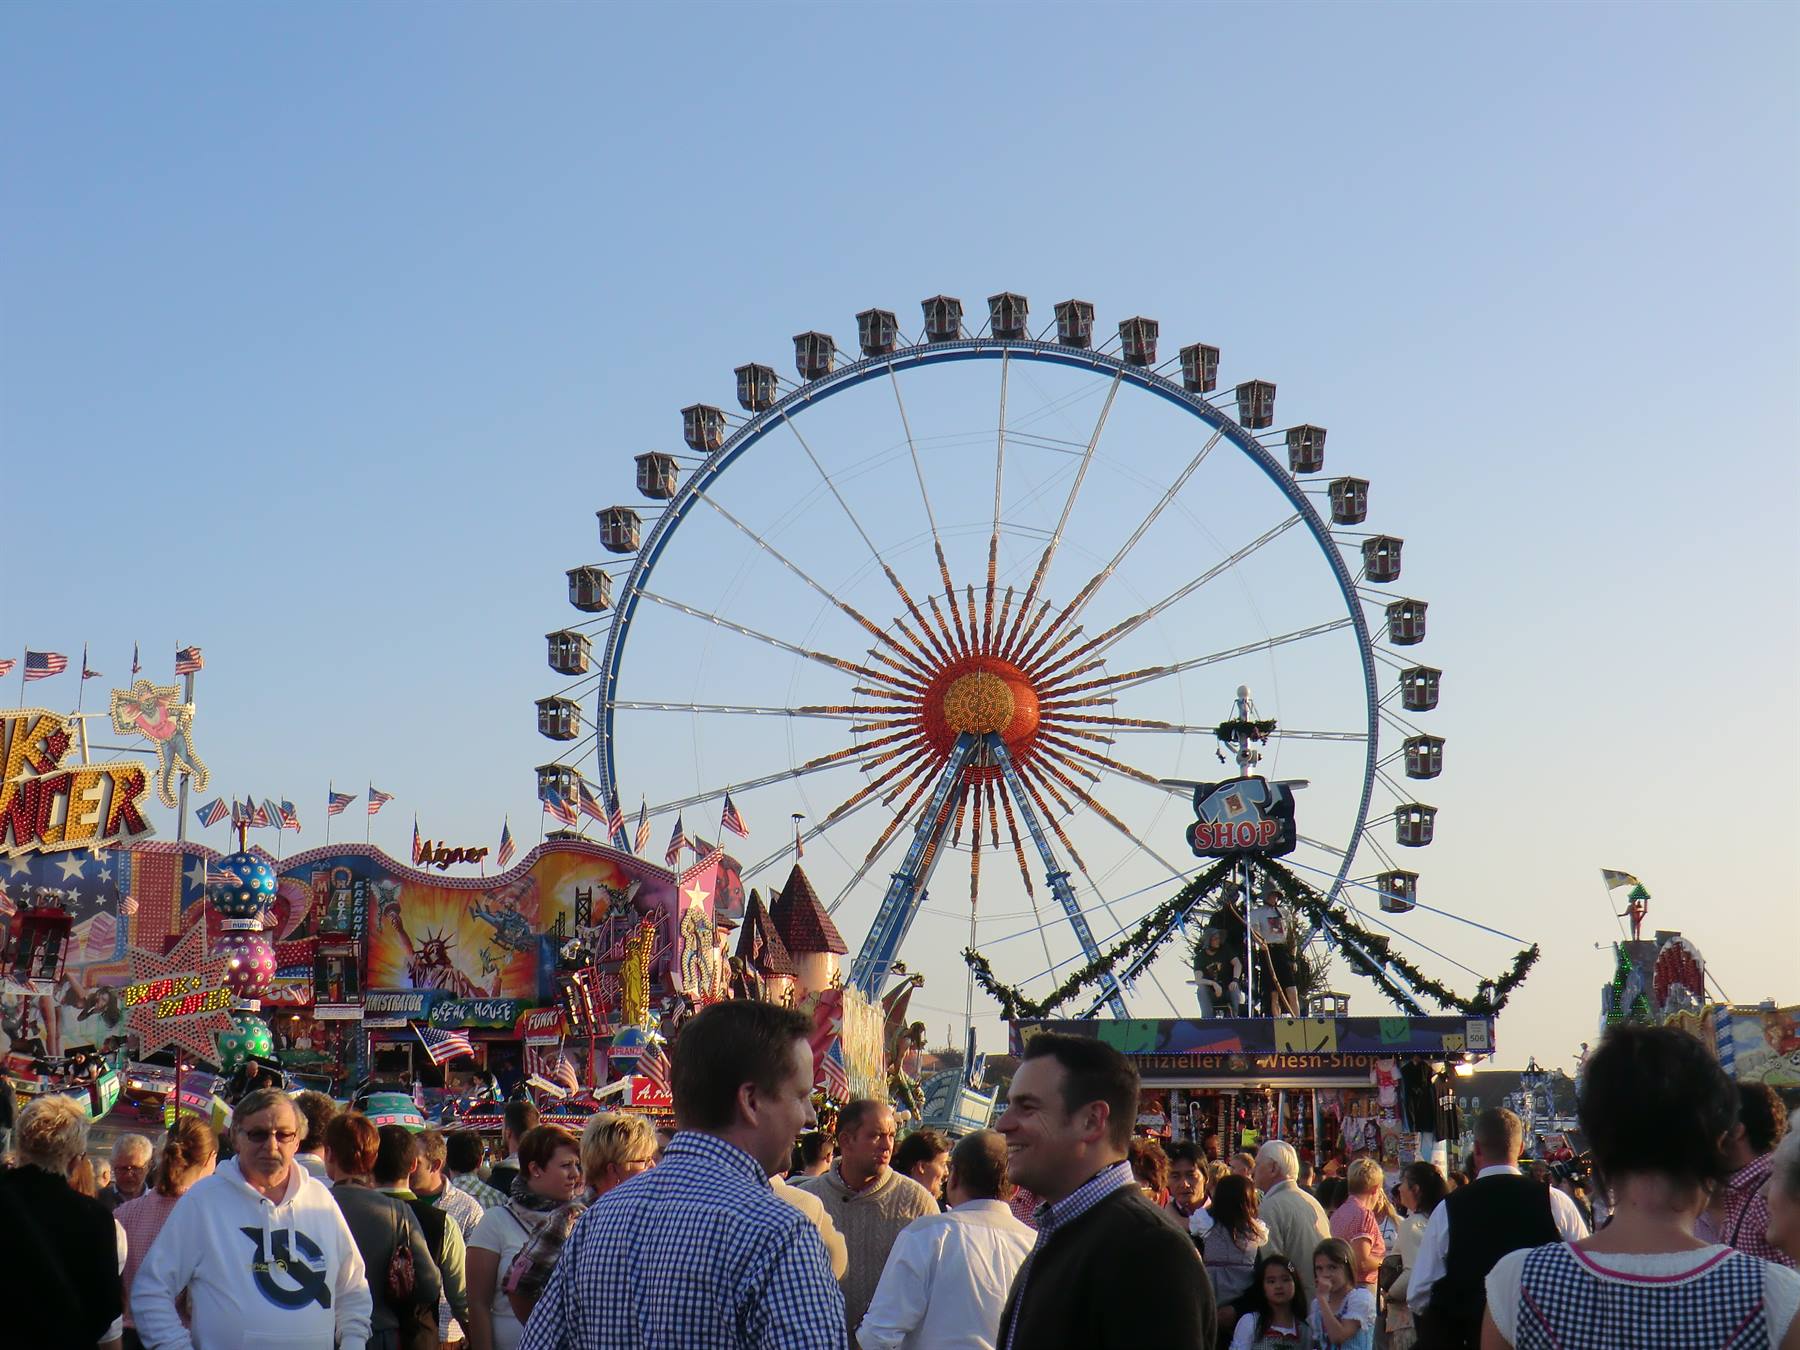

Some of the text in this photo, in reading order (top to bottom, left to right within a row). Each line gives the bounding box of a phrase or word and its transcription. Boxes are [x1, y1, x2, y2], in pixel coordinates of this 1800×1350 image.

[1194, 820, 1277, 849] SHOP
[416, 839, 488, 871] Aigner
[125, 976, 189, 1006] BREAK
[431, 1001, 512, 1022] BREAK HOUSE
[527, 1008, 564, 1031] FUNKY
